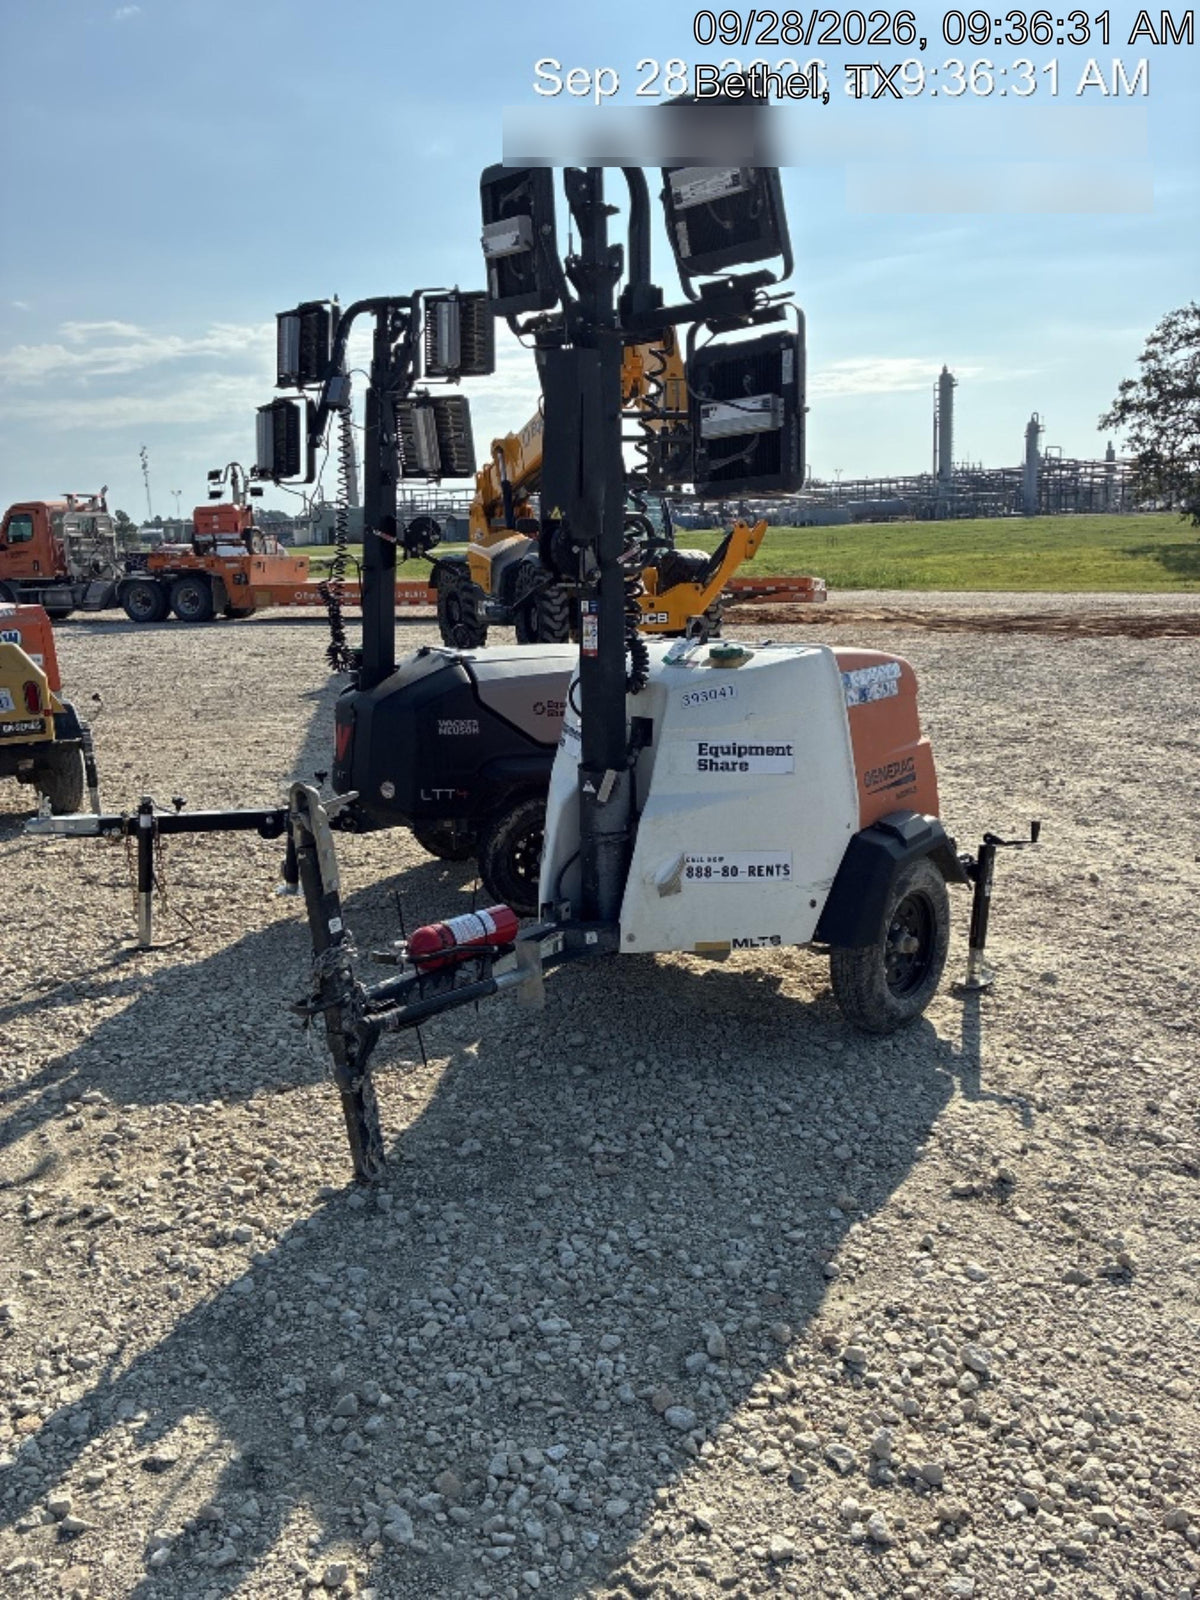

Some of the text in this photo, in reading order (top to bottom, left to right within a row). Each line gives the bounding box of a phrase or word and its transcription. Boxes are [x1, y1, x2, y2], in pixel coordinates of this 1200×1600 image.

[682, 685, 734, 707] 393041
[697, 742, 794, 758] Equipment
[697, 758, 749, 772] Share
[685, 863, 791, 879] 888-80-RENTS
